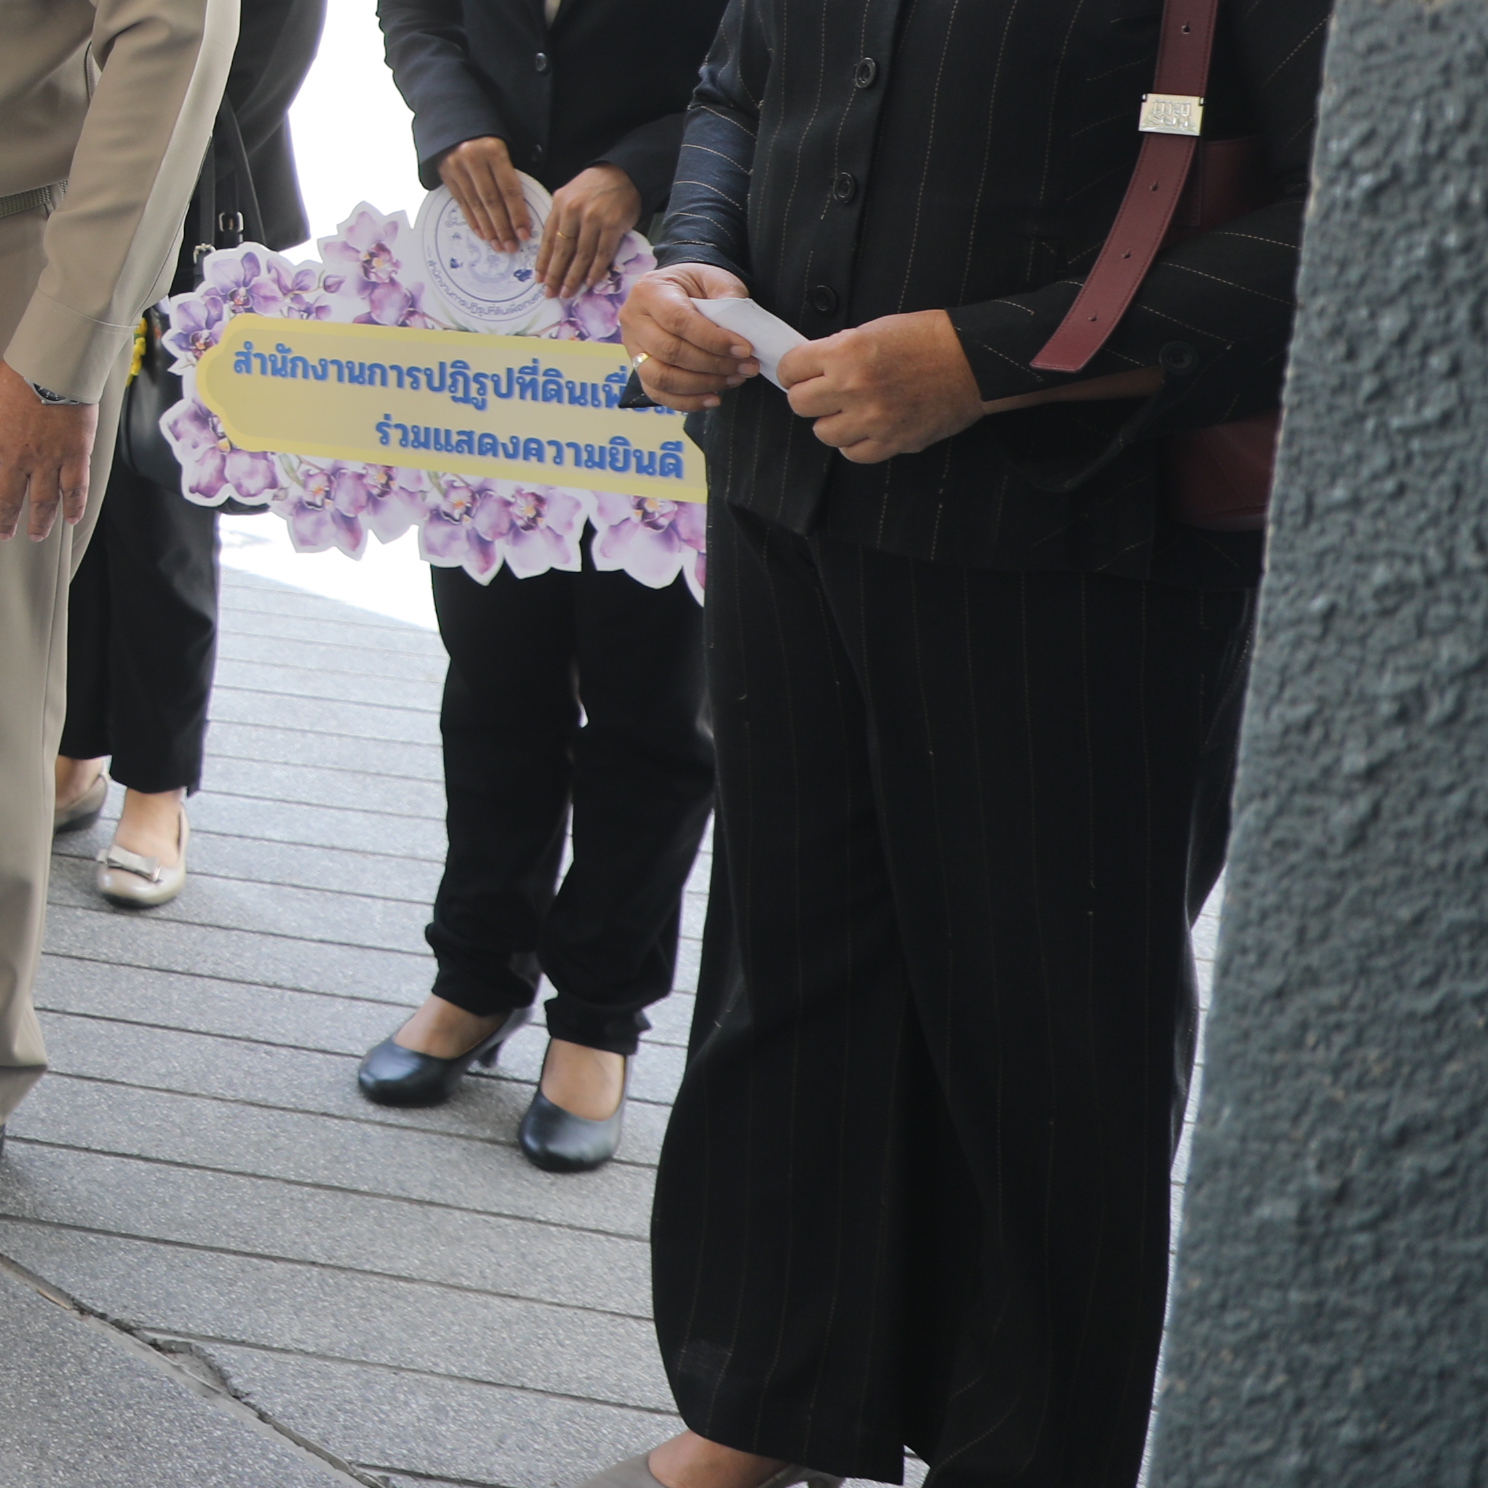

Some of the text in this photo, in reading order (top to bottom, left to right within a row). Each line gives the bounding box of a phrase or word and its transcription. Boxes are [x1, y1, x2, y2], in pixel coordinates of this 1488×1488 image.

[375, 414, 685, 480] ร่วมแสดงความยินดี
